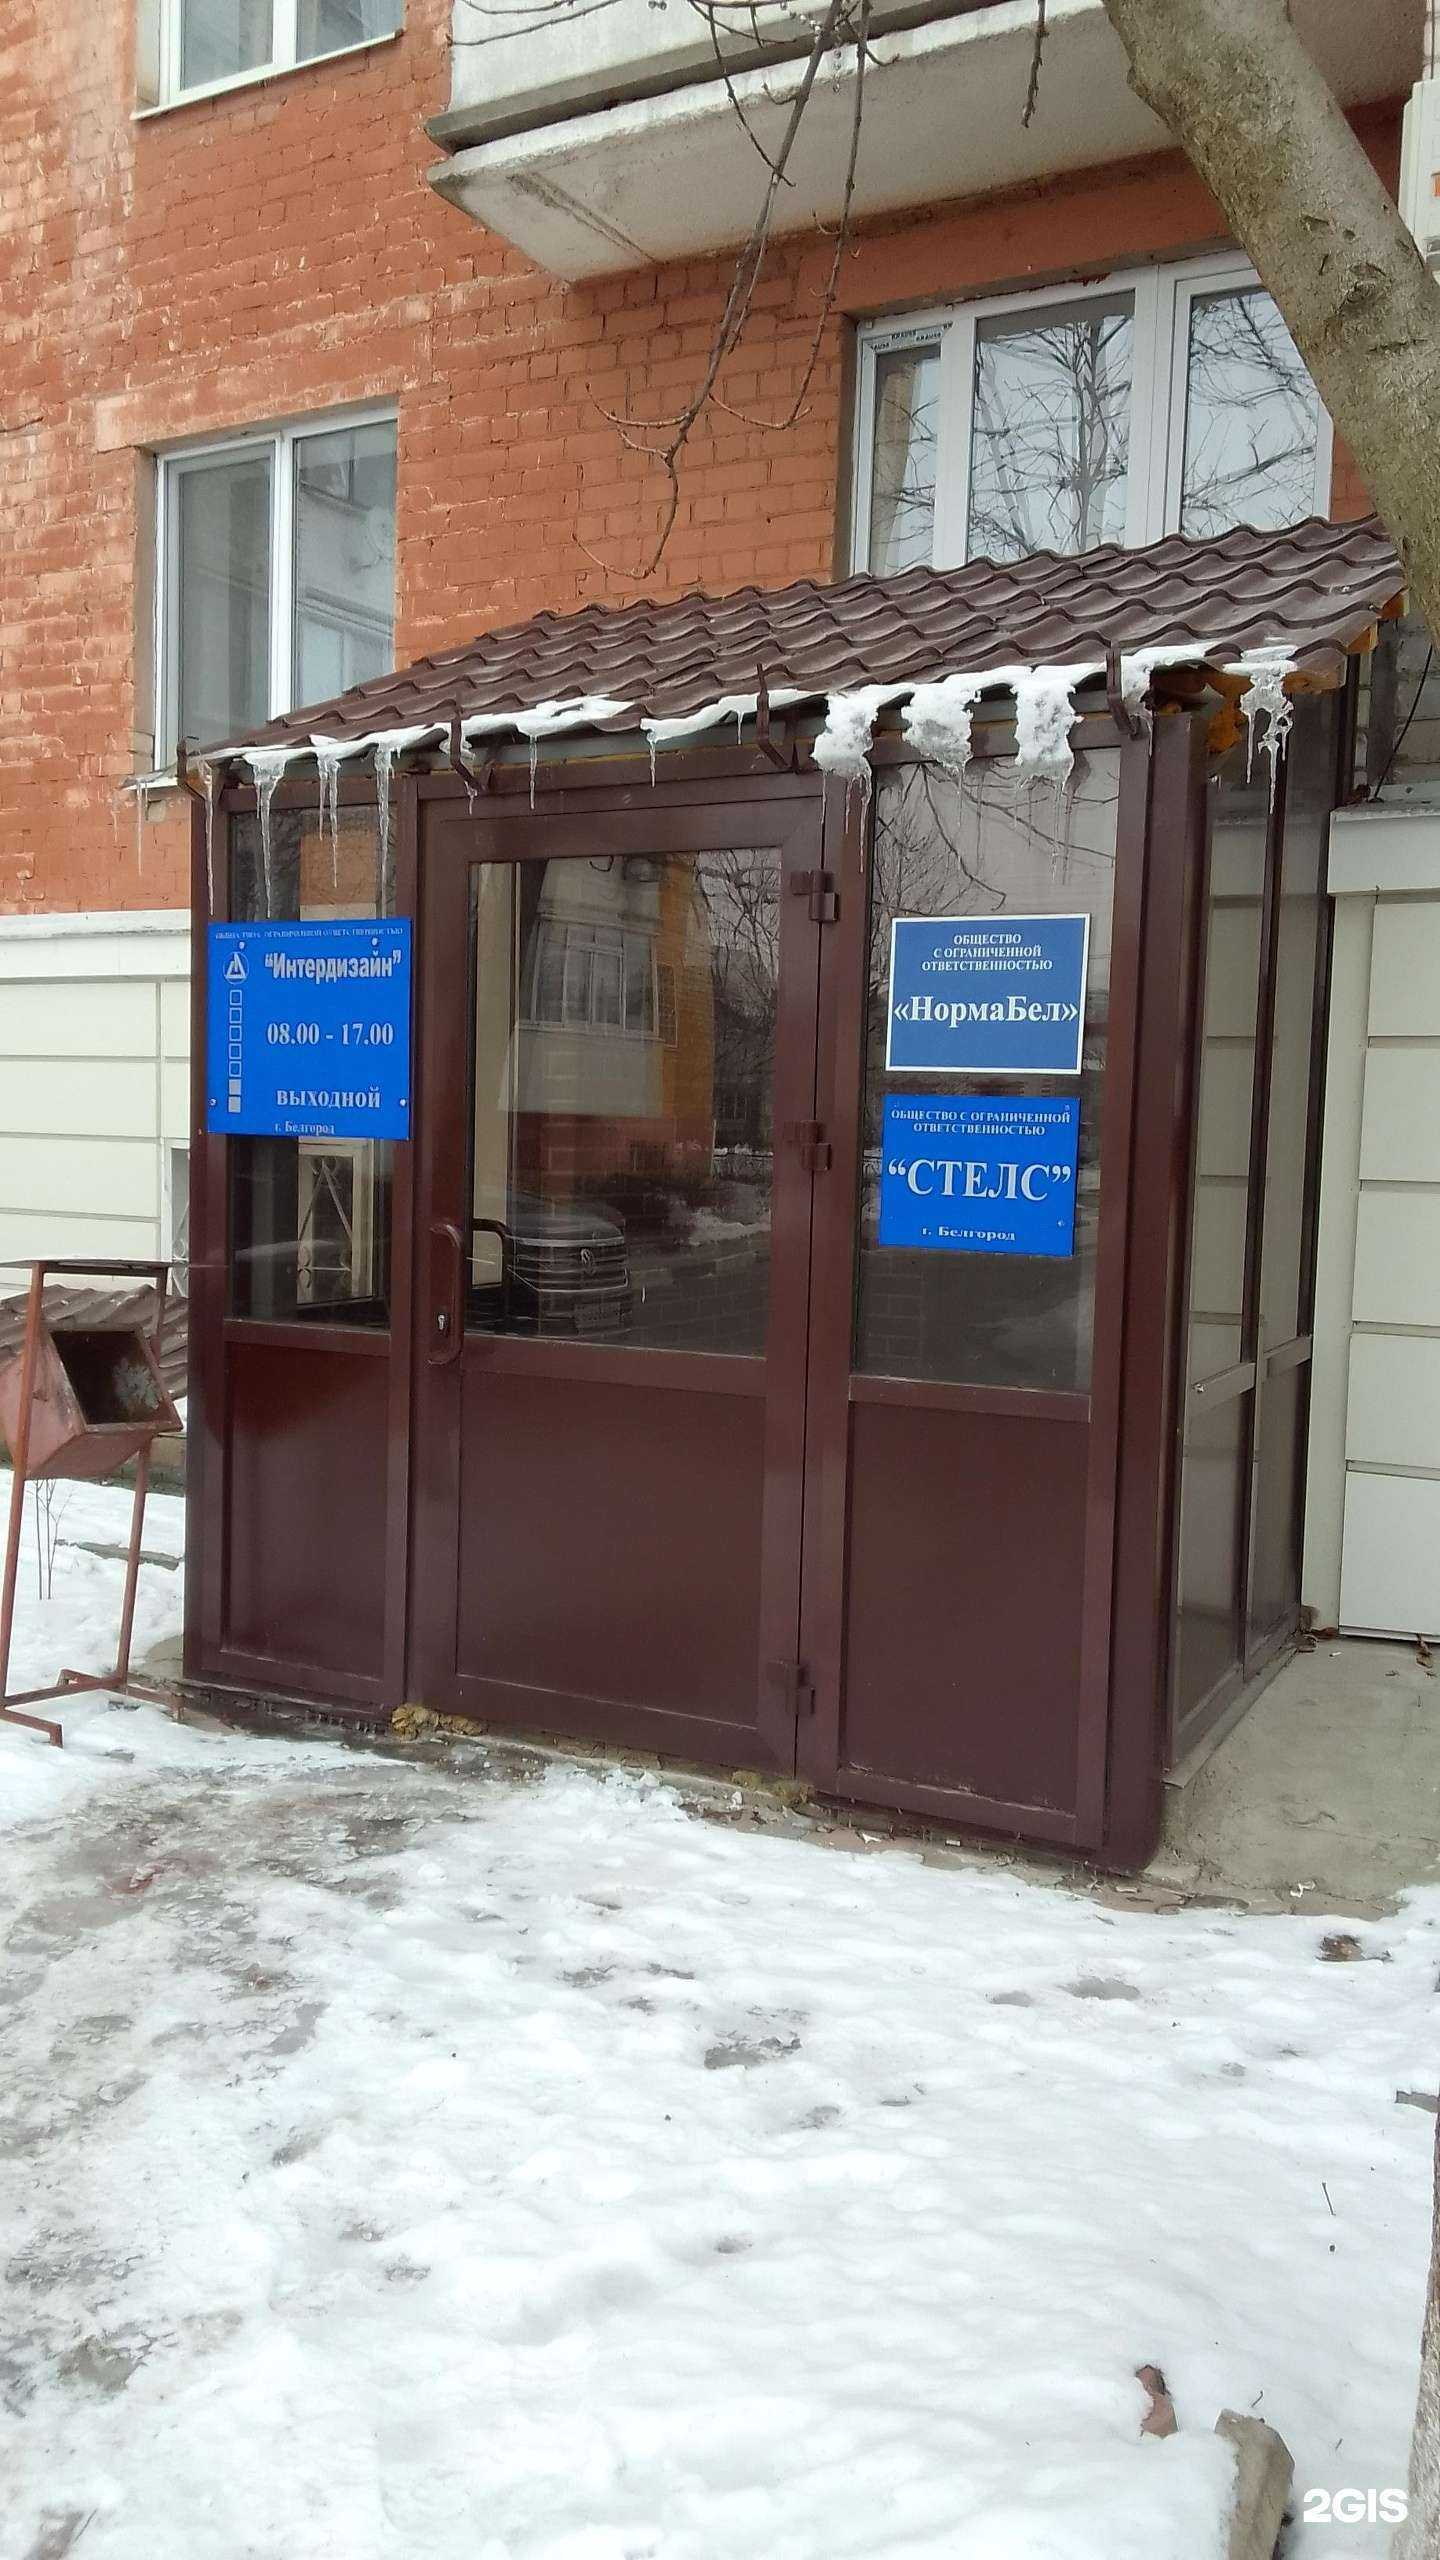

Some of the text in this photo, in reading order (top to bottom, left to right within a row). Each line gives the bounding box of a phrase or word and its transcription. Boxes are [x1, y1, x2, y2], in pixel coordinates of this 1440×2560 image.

[953, 933, 1022, 945] ОБЩЕСТВО
[933, 944, 1042, 959] С ОГРАНИЧЕННОЙ
[921, 960, 1053, 971] ОТВЕТСТВЕННОСТЬЮ
[893, 995, 1079, 1028] «НормаБел»
[267, 1022, 320, 1046] 08.00
[342, 1022, 394, 1046] 17.00
[891, 1109, 1071, 1123] ОБЩЕСТВО С ОГРАНИЧЕННОЙ
[284, 1121, 335, 1135] Белгород
[913, 1122, 1045, 1136] ОТВЕТСТВЕННОСТЬЮ
[888, 1158, 1072, 1201] “СТЕЛС”
[938, 1226, 1016, 1242] Белгород
